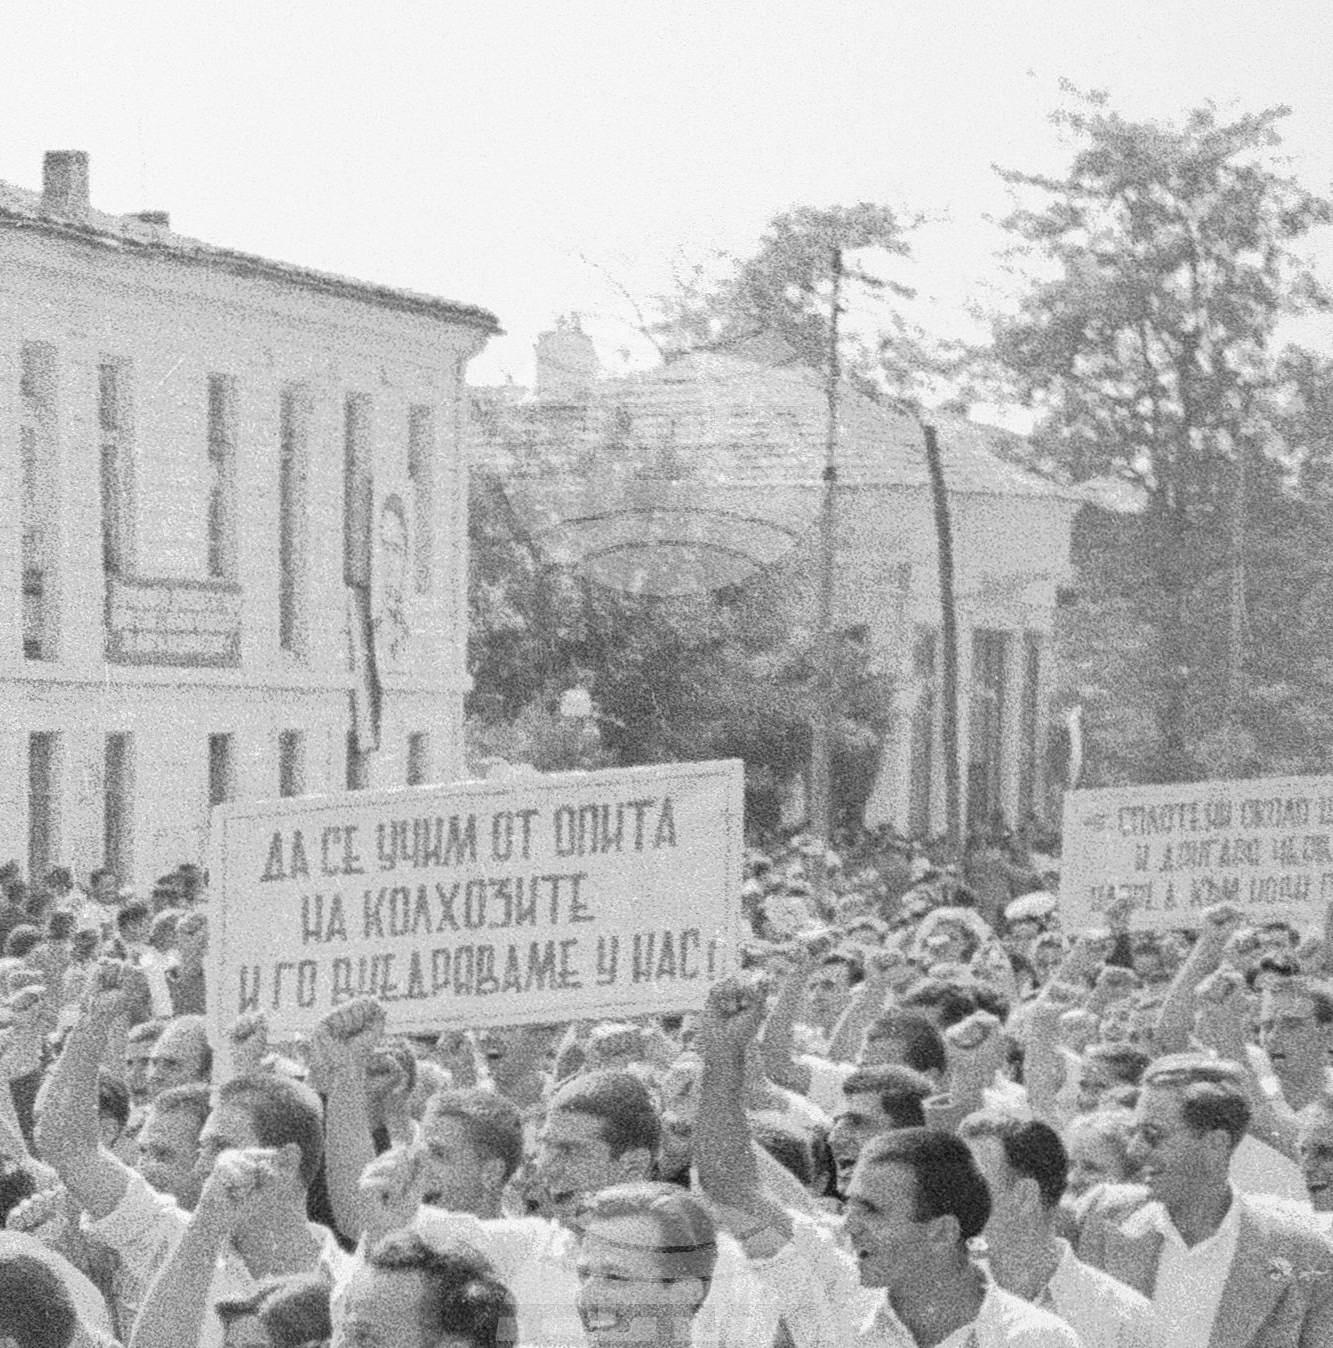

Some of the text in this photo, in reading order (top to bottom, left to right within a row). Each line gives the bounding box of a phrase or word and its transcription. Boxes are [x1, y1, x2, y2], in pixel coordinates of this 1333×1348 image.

[259, 797, 678, 883] ДА СЕ УЧИМ ОТ ОПИТА
[301, 872, 596, 945] НА КОЛХОЗИТЕ
[237, 963, 261, 1013] И
[272, 959, 317, 1009] ГО
[596, 935, 619, 985] У
[631, 927, 717, 984] НАС!
